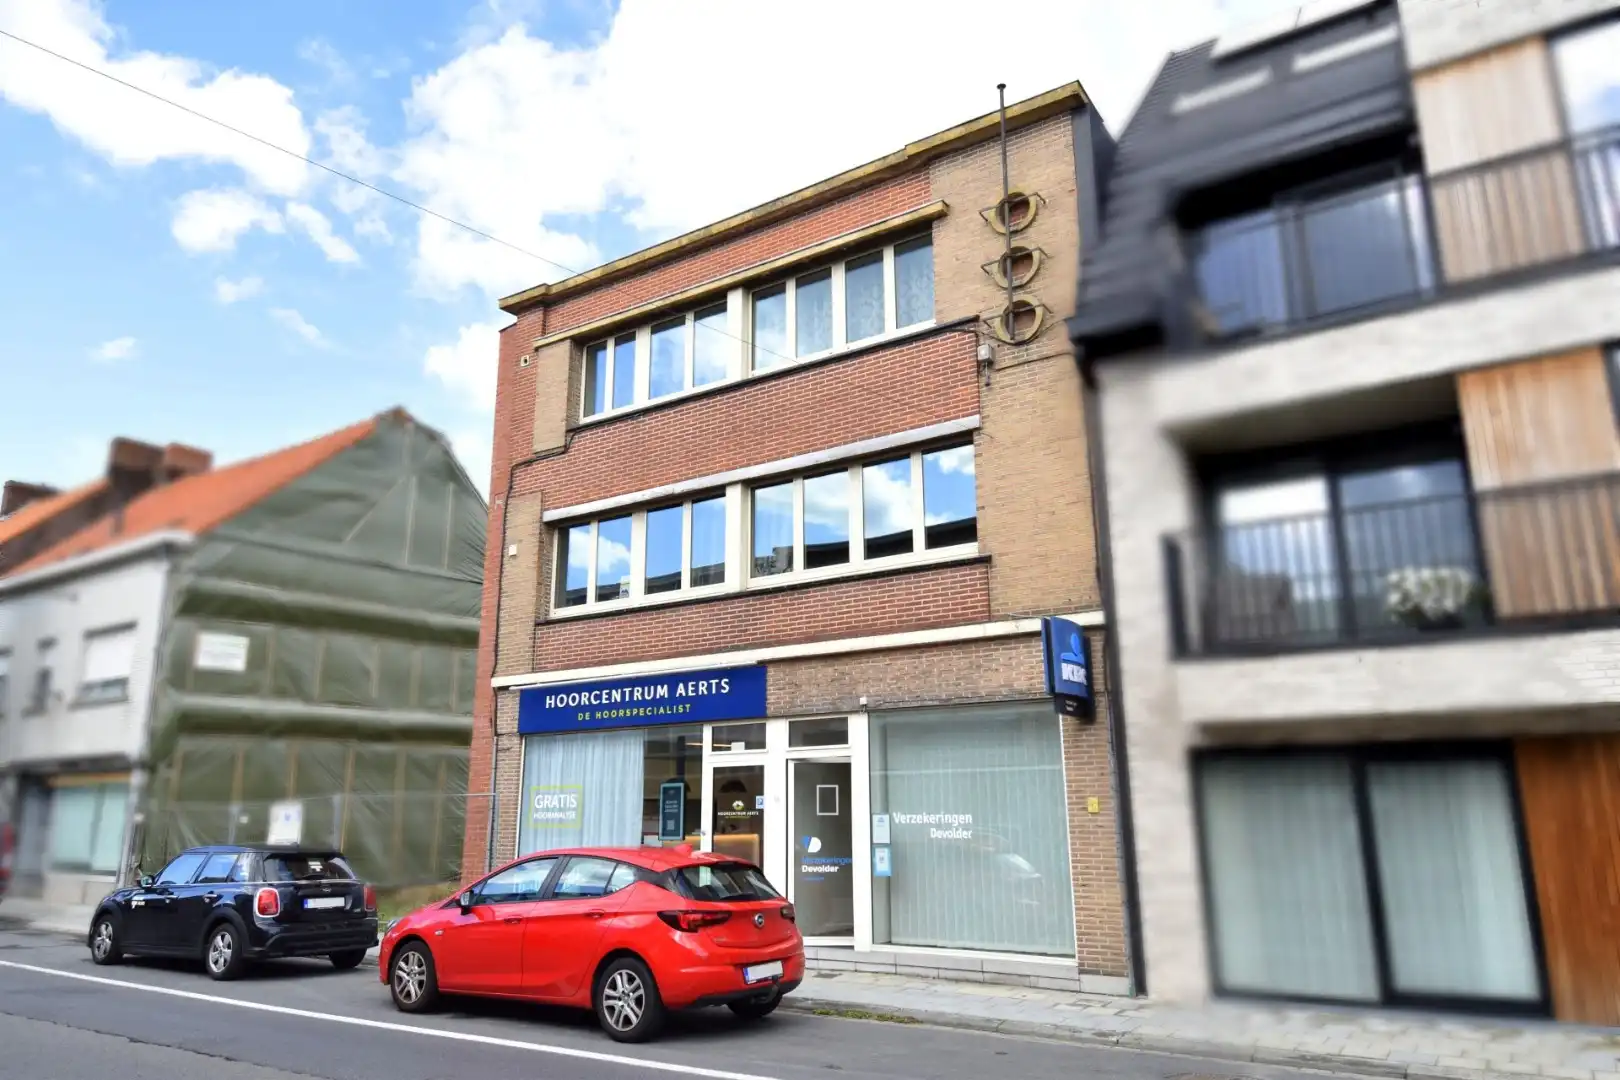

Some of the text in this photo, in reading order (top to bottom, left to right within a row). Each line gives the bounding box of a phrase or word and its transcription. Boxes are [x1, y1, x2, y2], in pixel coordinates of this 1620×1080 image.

[545, 678, 730, 709] HOORCENTRUM AERTS
[578, 704, 691, 721] DE HOORSPECIALIST
[534, 792, 578, 809] GRATIS
[893, 812, 973, 827] Verzekeringen
[930, 828, 973, 839] Devolder
[801, 865, 840, 873] Devolder
